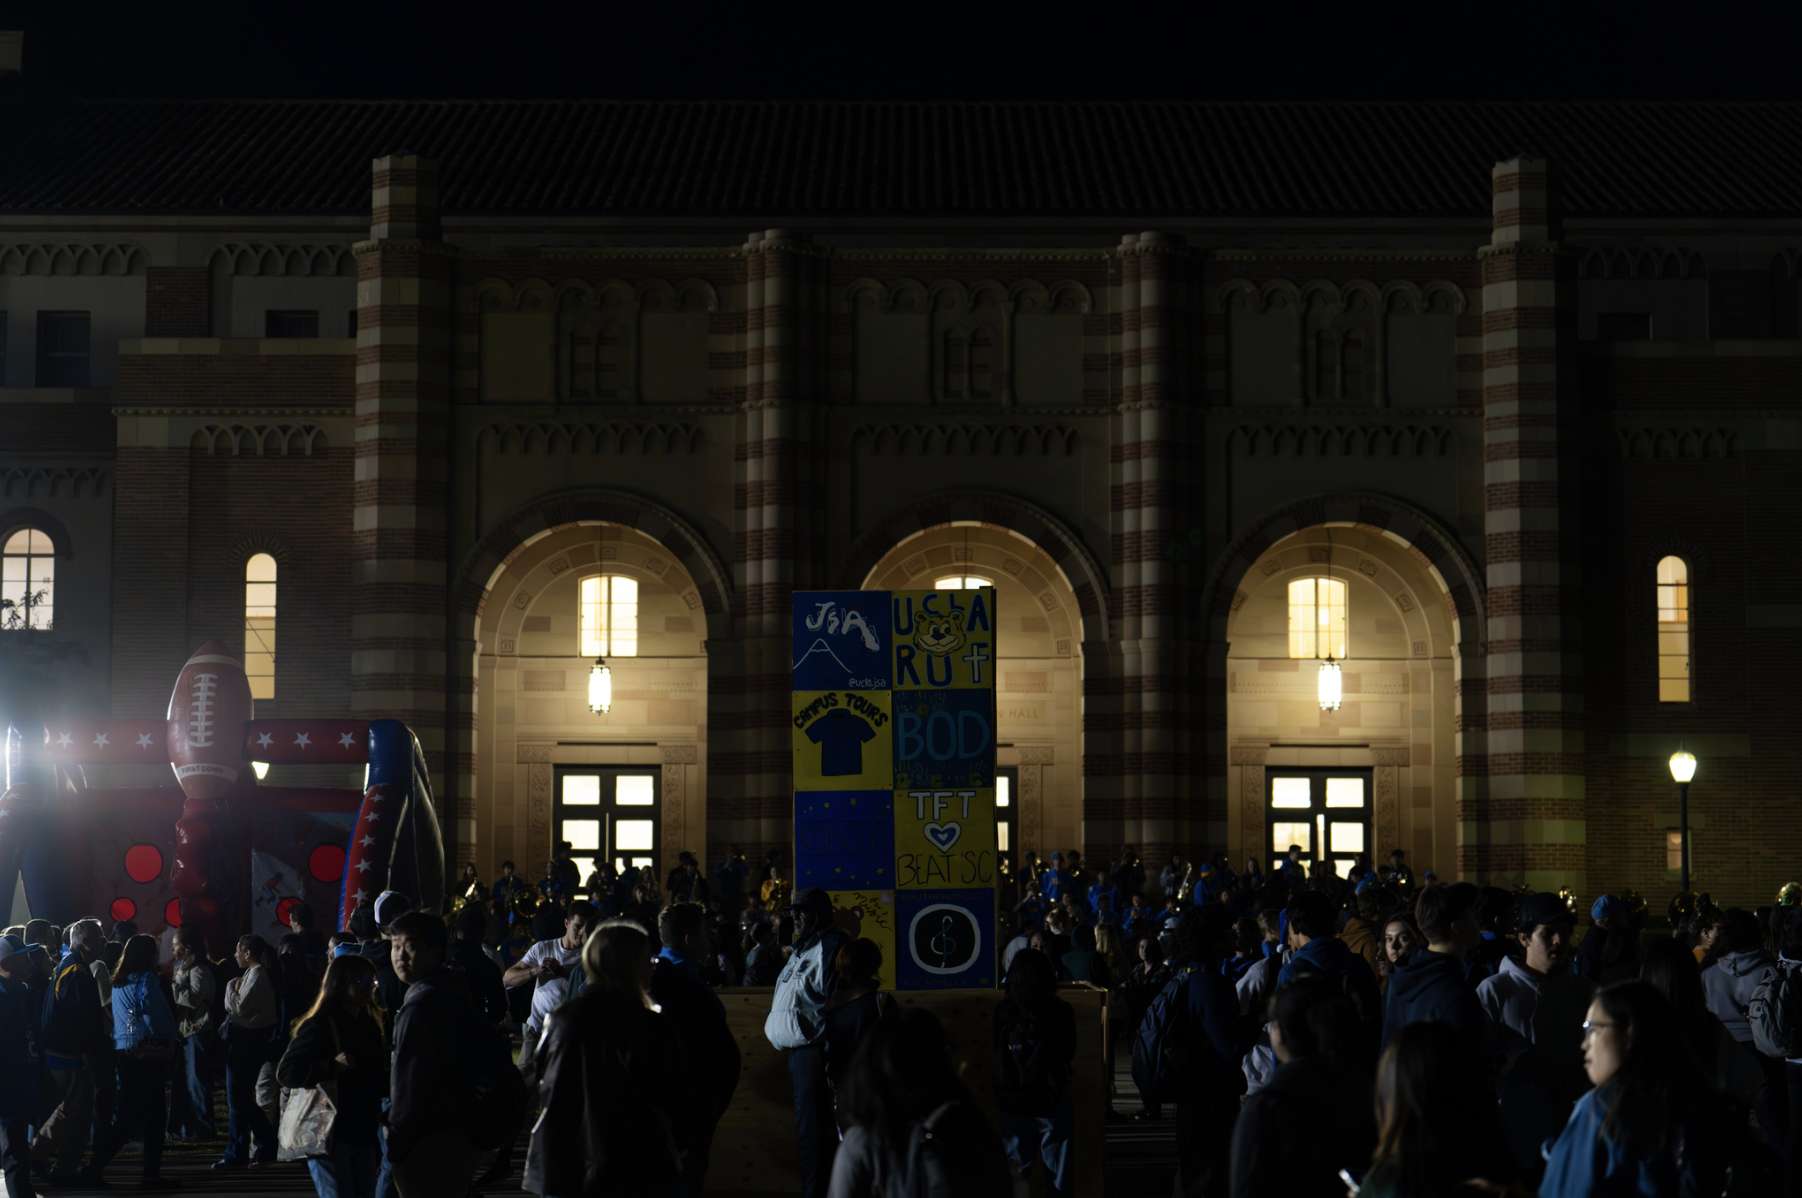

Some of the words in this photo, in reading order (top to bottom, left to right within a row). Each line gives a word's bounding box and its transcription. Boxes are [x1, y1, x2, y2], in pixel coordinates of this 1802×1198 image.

[806, 601, 880, 652] JSA
[893, 593, 991, 636] UCLA
[849, 677, 886, 690] @ucla.jsa
[793, 692, 839, 729] CAMPUS
[845, 693, 888, 727] TOURS
[1009, 707, 1039, 719] HALL
[898, 710, 990, 761] BOD
[182, 765, 200, 774] FIRST
[908, 791, 976, 820] TFT
[897, 852, 956, 886] BEAT
